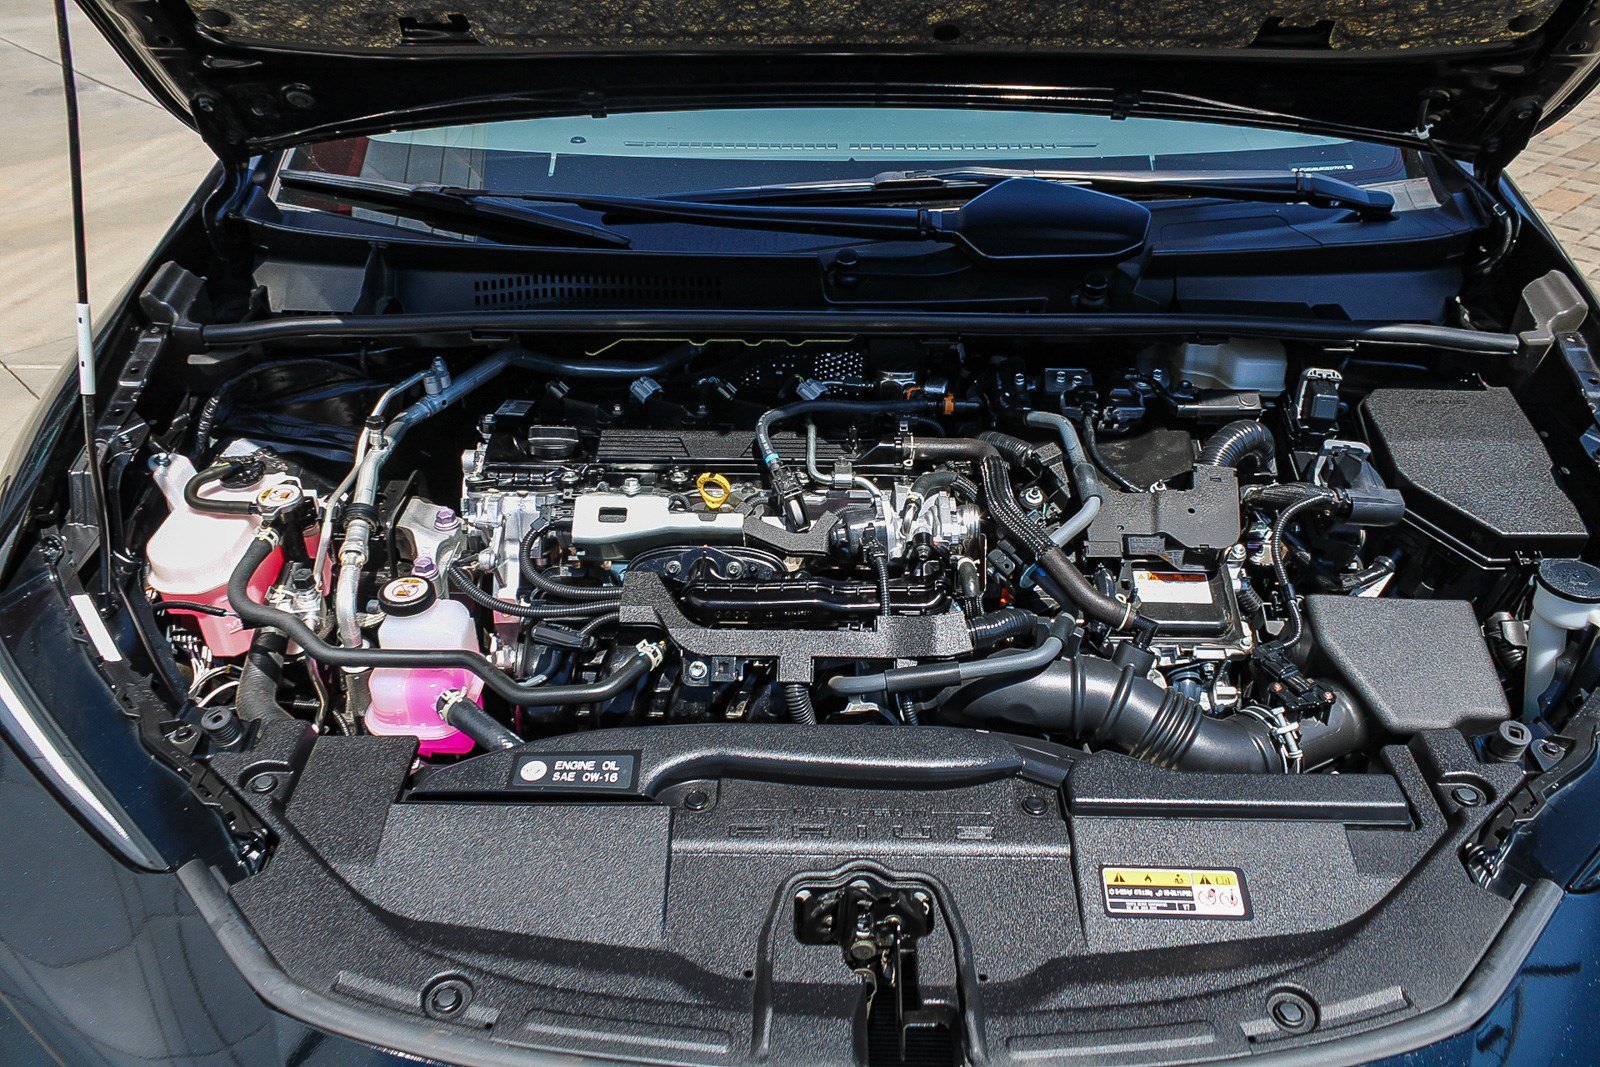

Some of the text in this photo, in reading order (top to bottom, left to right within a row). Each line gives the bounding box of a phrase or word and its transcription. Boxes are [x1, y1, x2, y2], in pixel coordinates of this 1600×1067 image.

[554, 760, 621, 771] ENGINE OIL
[552, 771, 577, 782] SAE
